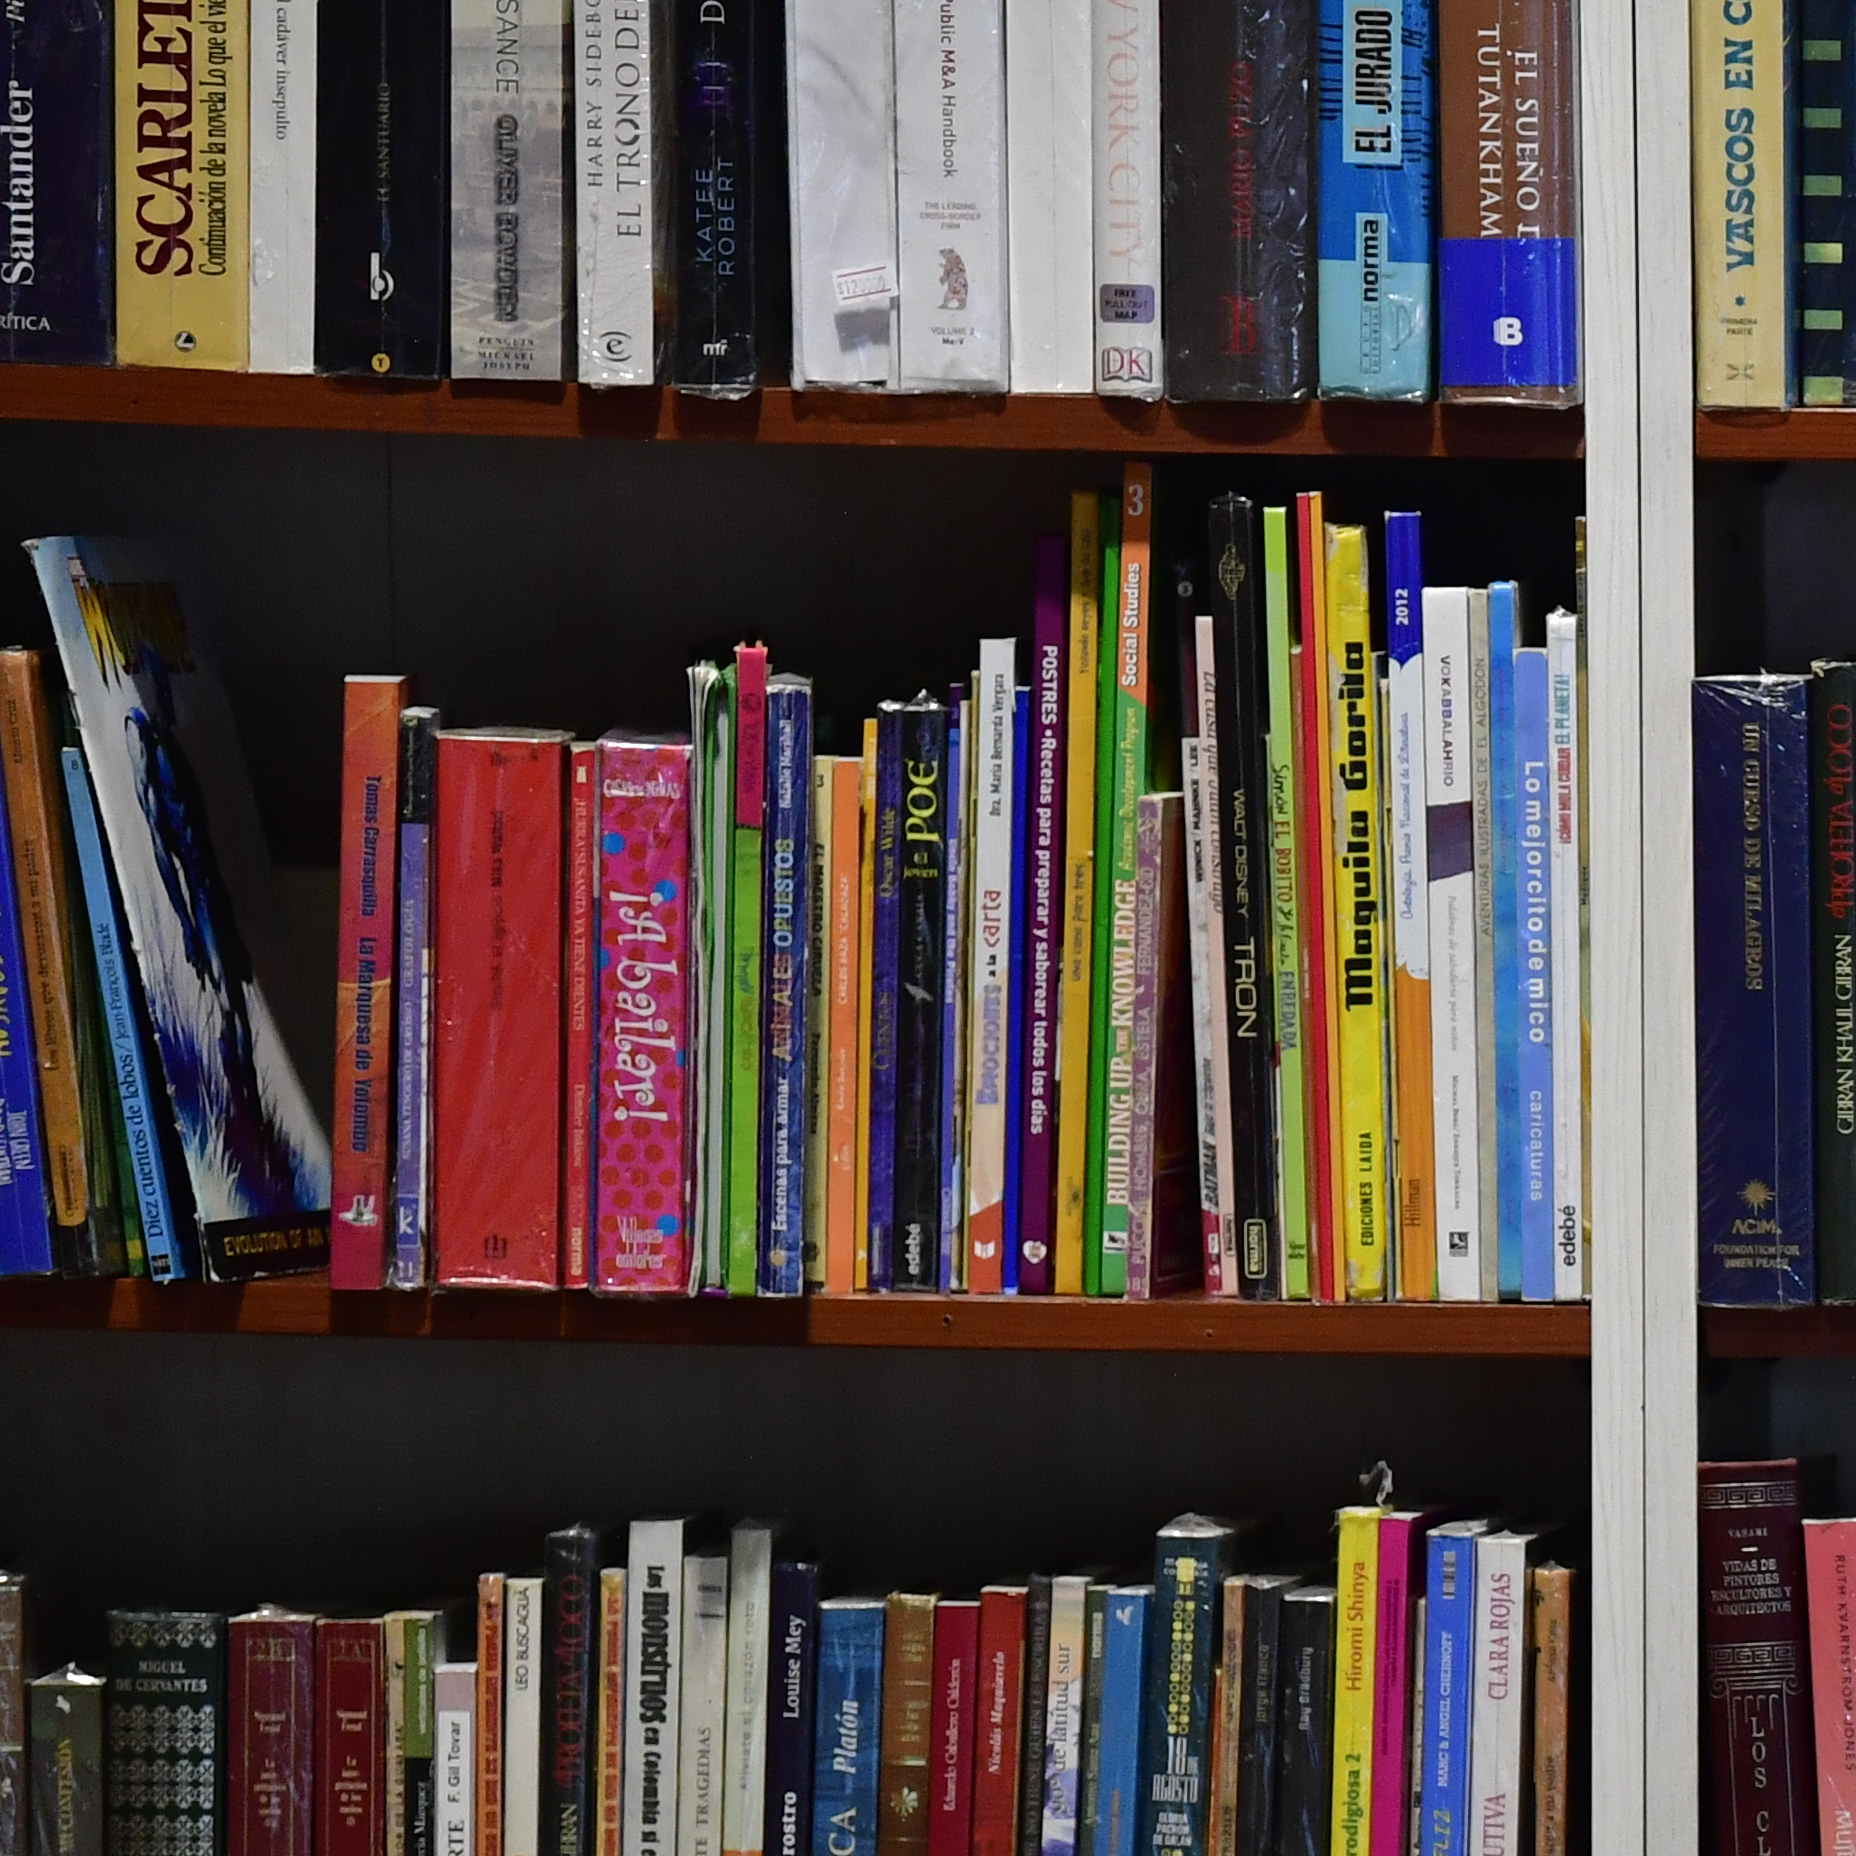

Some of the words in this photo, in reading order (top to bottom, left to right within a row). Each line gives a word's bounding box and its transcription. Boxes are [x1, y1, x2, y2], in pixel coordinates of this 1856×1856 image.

[199, 20, 227, 34] el
[202, 38, 229, 65] que
[199, 69, 227, 87] Lo
[941, 50, 956, 88] M&A
[1354, 10, 1393, 115] JURADO
[1515, 50, 1538, 78] EL
[1725, 38, 1753, 90] EN
[199, 92, 227, 138] novela
[586, 101, 604, 187] HARRY
[941, 95, 957, 178] Handbook
[1356, 125, 1392, 153] EL
[199, 141, 227, 155] la
[199, 159, 227, 177] de
[1515, 95, 1543, 211] SUEÑO
[1, 81, 34, 285] Santander
[1726, 107, 1755, 272] VASCOS
[199, 181, 227, 275] Continuación
[617, 205, 643, 237] EL
[695, 168, 713, 262] KATEE
[717, 156, 735, 274] ROBERT
[1362, 219, 1379, 301] norma
[1124, 562, 1142, 624] Studies
[1395, 588, 1410, 625] 2012
[1123, 628, 1140, 687] Social
[1339, 641, 1369, 789] Gorila
[1524, 759, 1543, 793] Lo
[775, 838, 793, 947] OPUESTOS
[1525, 797, 1546, 934] mejorcito
[1525, 938, 1546, 969] de
[772, 954, 793, 1061] ANIMALES
[1236, 938, 1258, 1036] TRON
[1527, 977, 1548, 1042] mico
[613, 950, 678, 1122] bailar!
[776, 1076, 788, 1125] armar
[774, 1129, 790, 1165] para
[1358, 1131, 1373, 1172] LAIDA
[772, 1169, 788, 1231] Escenas
[1360, 1180, 1375, 1246] EDICIONES
[1556, 1205, 1578, 1266] edebé
[1348, 1561, 1367, 1621] Shinya
[1489, 1573, 1513, 1628] ROJAS
[784, 1615, 805, 1654] Mey
[1346, 1626, 1364, 1692] Hiromi
[782, 1659, 801, 1719] Louise
[1488, 1633, 1510, 1701] CLARA
[832, 1699, 860, 1773] Platón
[780, 1791, 797, 1856] rostro
